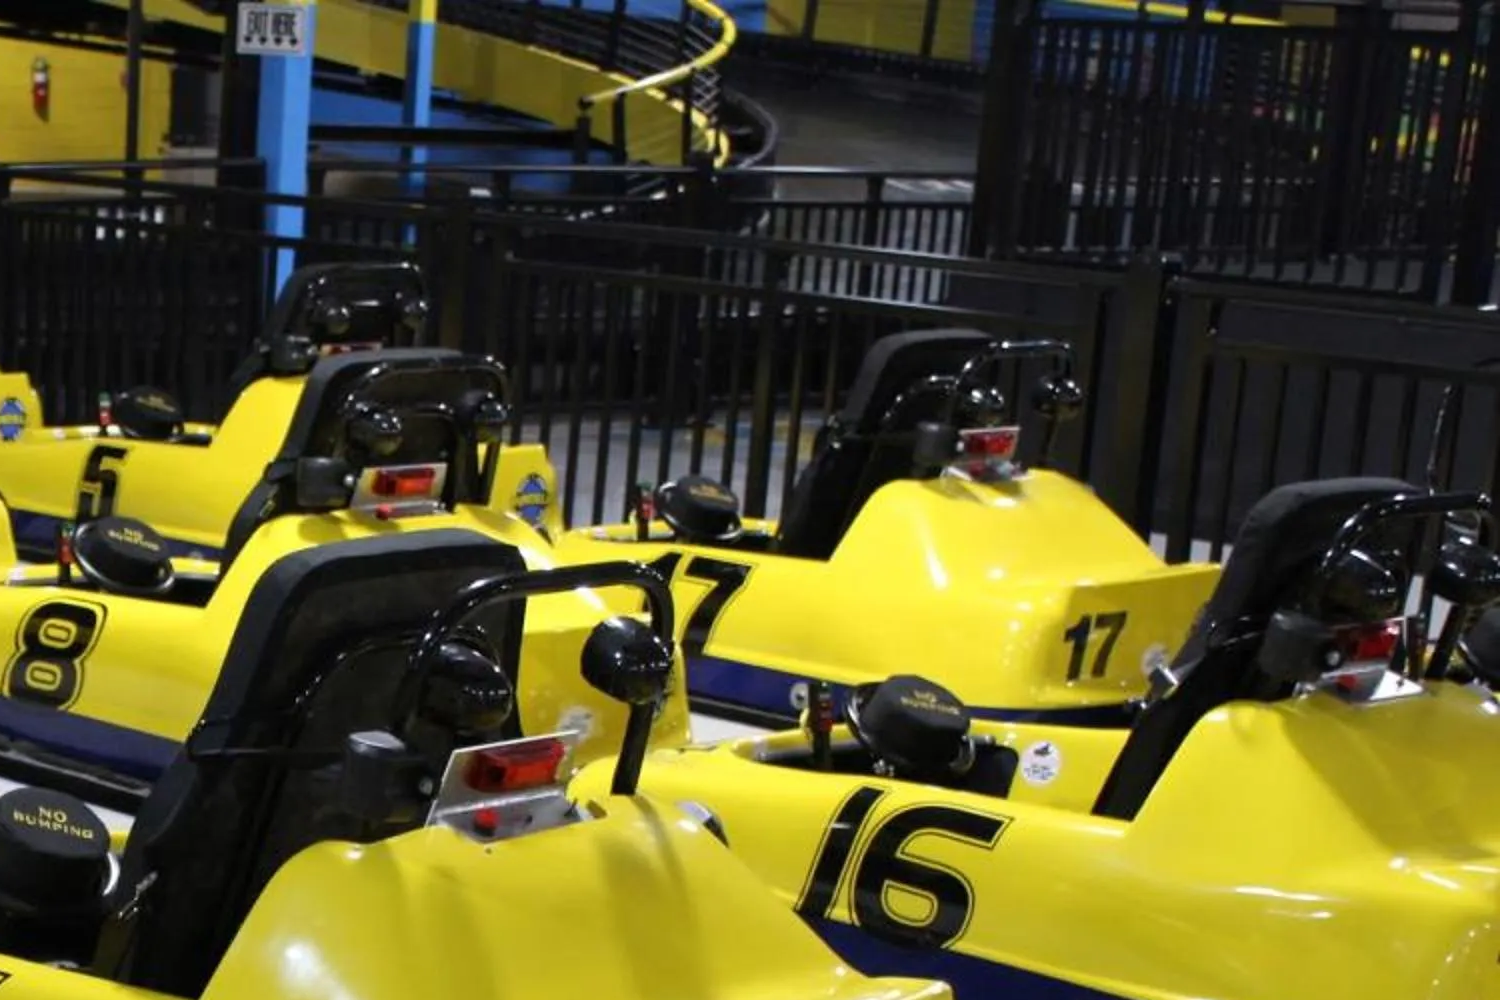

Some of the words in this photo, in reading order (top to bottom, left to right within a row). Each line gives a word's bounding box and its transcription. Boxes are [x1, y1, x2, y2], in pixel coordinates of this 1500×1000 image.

[1, 600, 106, 710] 8
[1064, 611, 1128, 681] 17
[13, 809, 94, 839] BUMPING
[38, 806, 68, 823] NO
[793, 786, 1014, 949] 16
